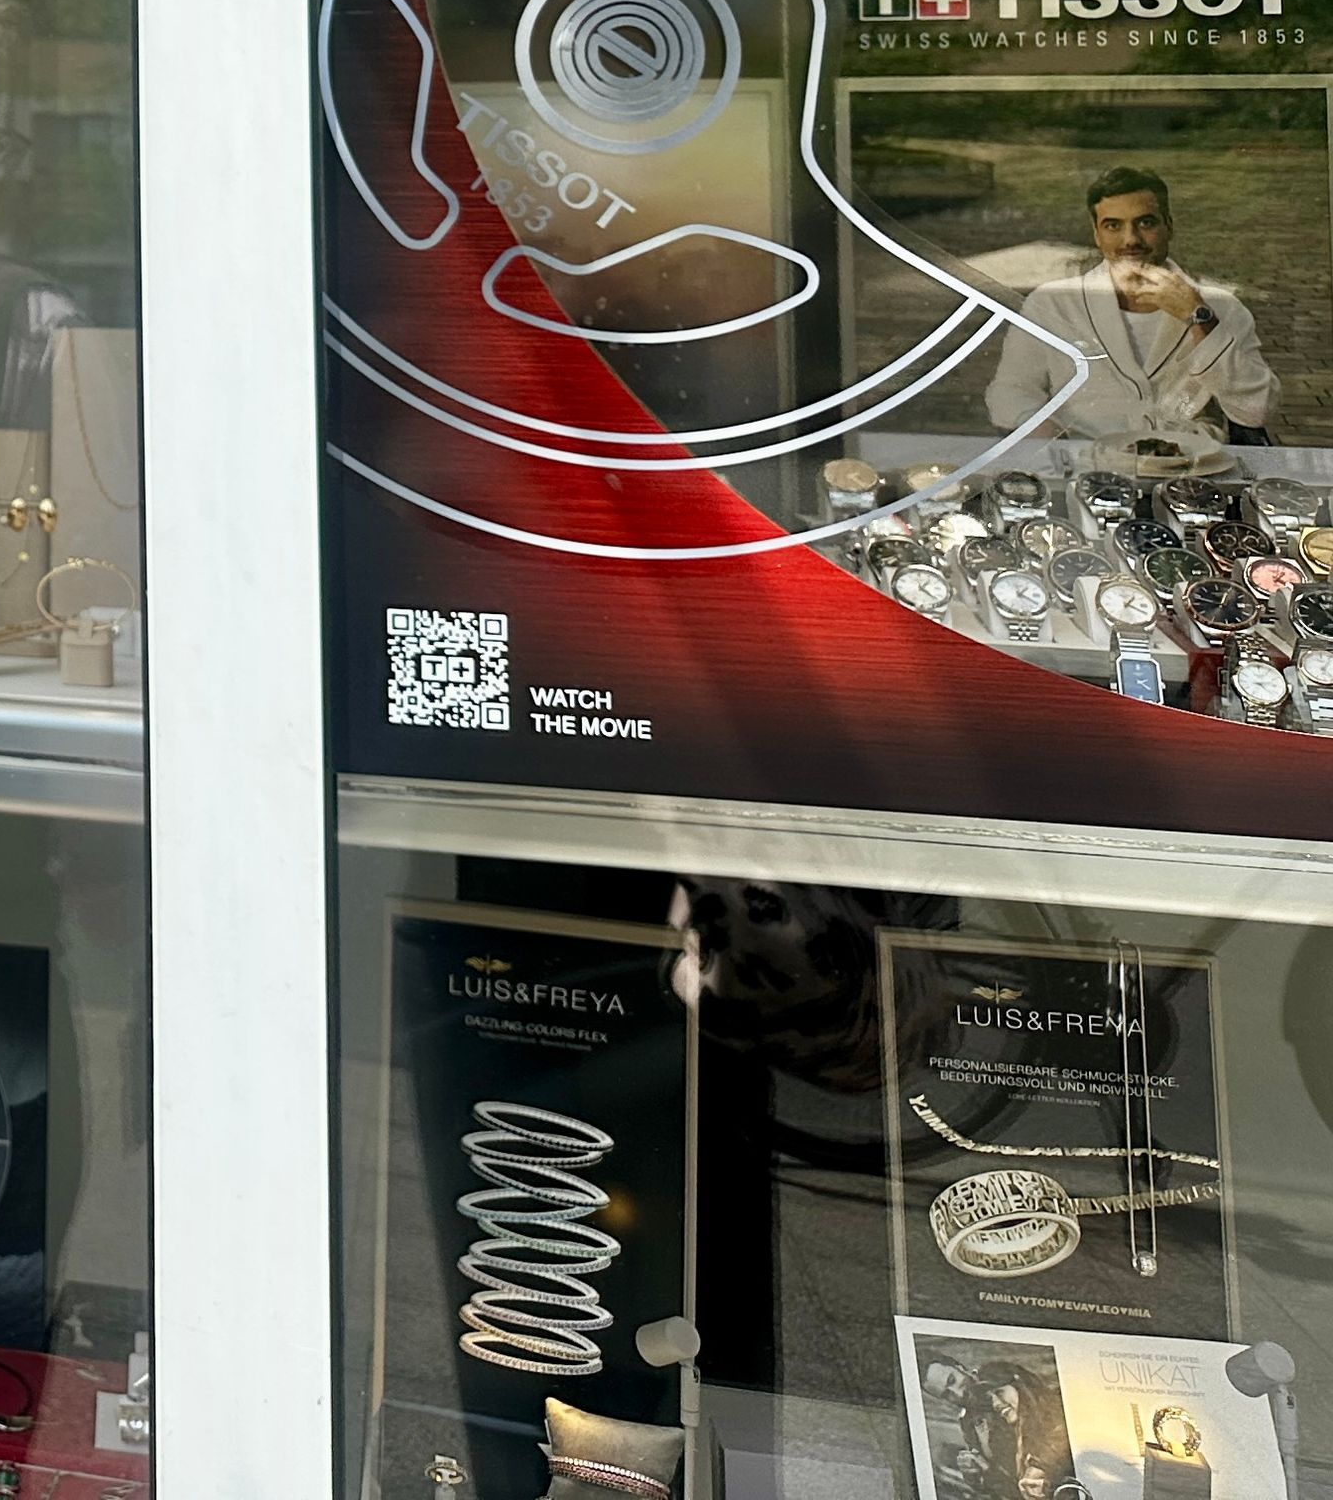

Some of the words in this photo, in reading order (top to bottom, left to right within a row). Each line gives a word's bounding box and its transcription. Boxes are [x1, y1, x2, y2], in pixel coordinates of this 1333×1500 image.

[859, 30, 951, 50] SWISS
[968, 28, 1109, 49] WATCHES
[1127, 27, 1222, 48] SINCE
[1239, 26, 1307, 47] 1853
[455, 91, 637, 232] TISSOT
[530, 685, 613, 711] WATCH
[530, 713, 576, 736] THE
[580, 716, 653, 741] MOVIE
[448, 973, 626, 1016] LUIS&FREYA
[464, 1014, 523, 1032] DAZZLING
[525, 1022, 577, 1039] COLORS
[578, 1029, 609, 1044] FLEX
[956, 1003, 1145, 1038] LUIS&FREYA
[929, 1056, 1059, 1079] PERSONALISIERBARE
[940, 1070, 1055, 1091] BEDEUTUNGSVOLL
[1058, 1080, 1086, 1093] UND
[1098, 1359, 1201, 1389] UNIKAT
